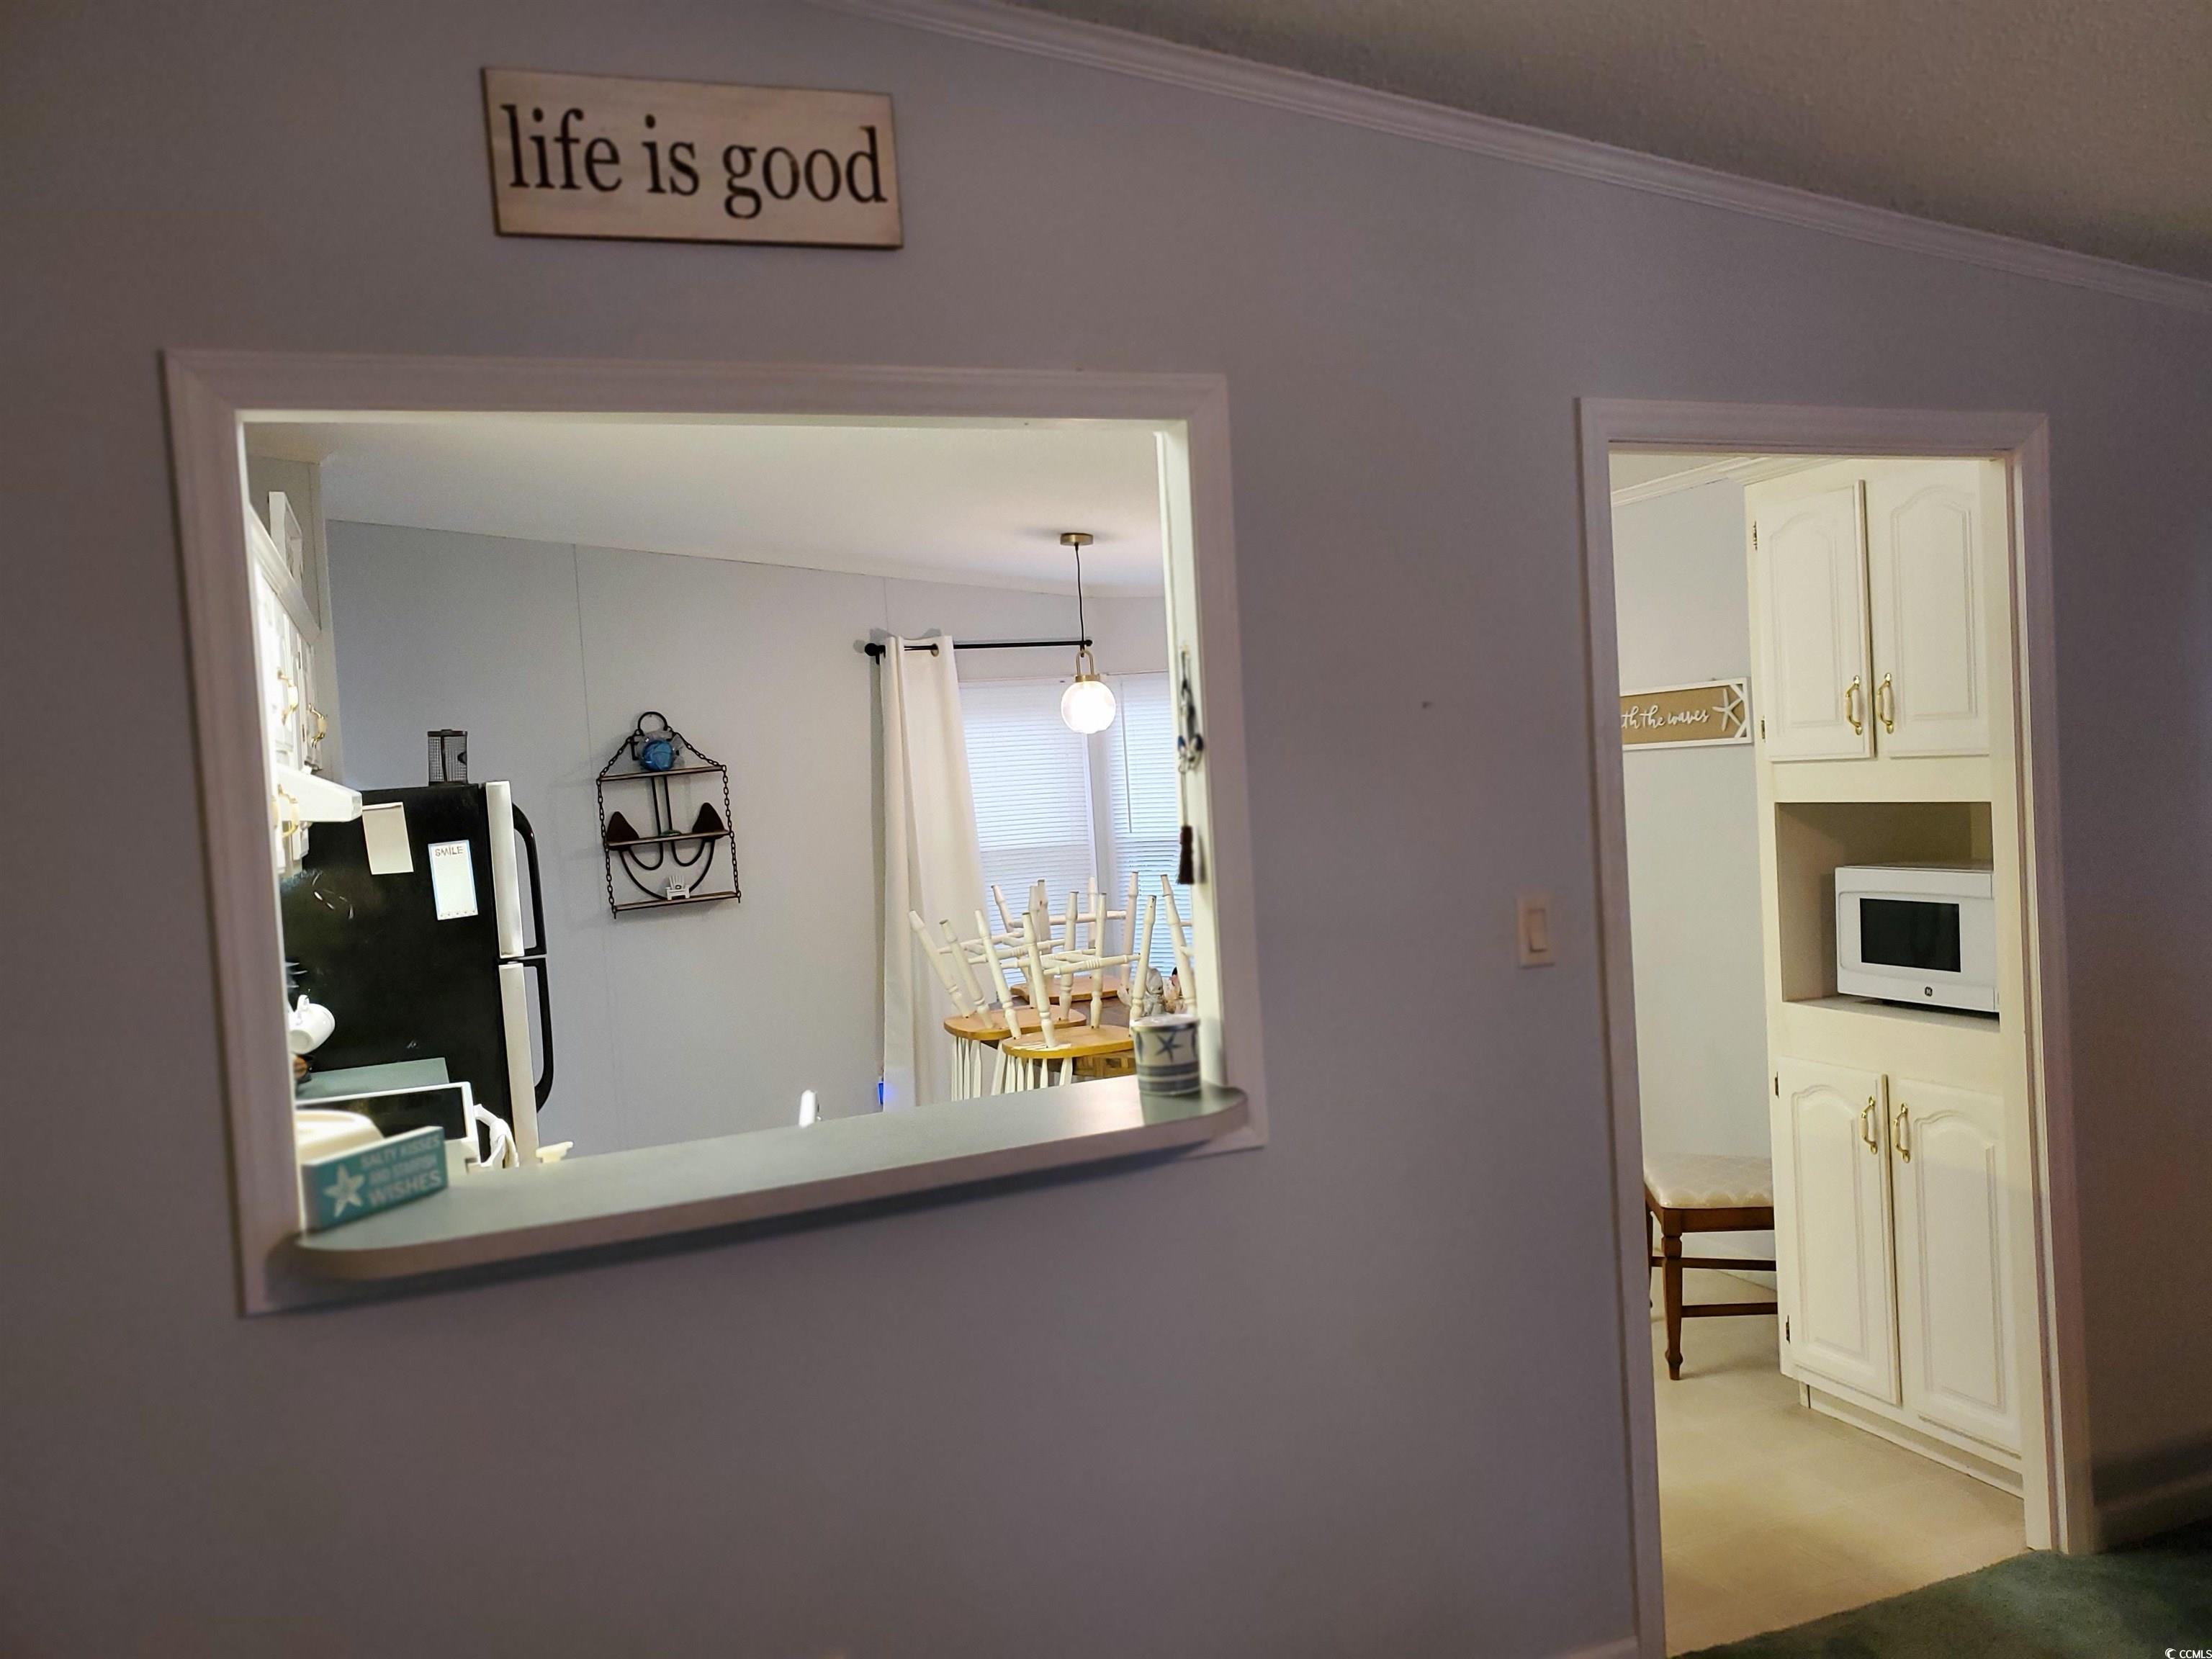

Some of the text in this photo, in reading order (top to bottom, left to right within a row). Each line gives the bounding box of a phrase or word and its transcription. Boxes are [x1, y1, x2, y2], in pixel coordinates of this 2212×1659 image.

[500, 103, 887, 219] life is good
[1640, 705, 1665, 728] the
[1668, 709, 1710, 726] waves
[435, 846, 464, 857] SMILE
[369, 1170, 441, 1207] WISHES
